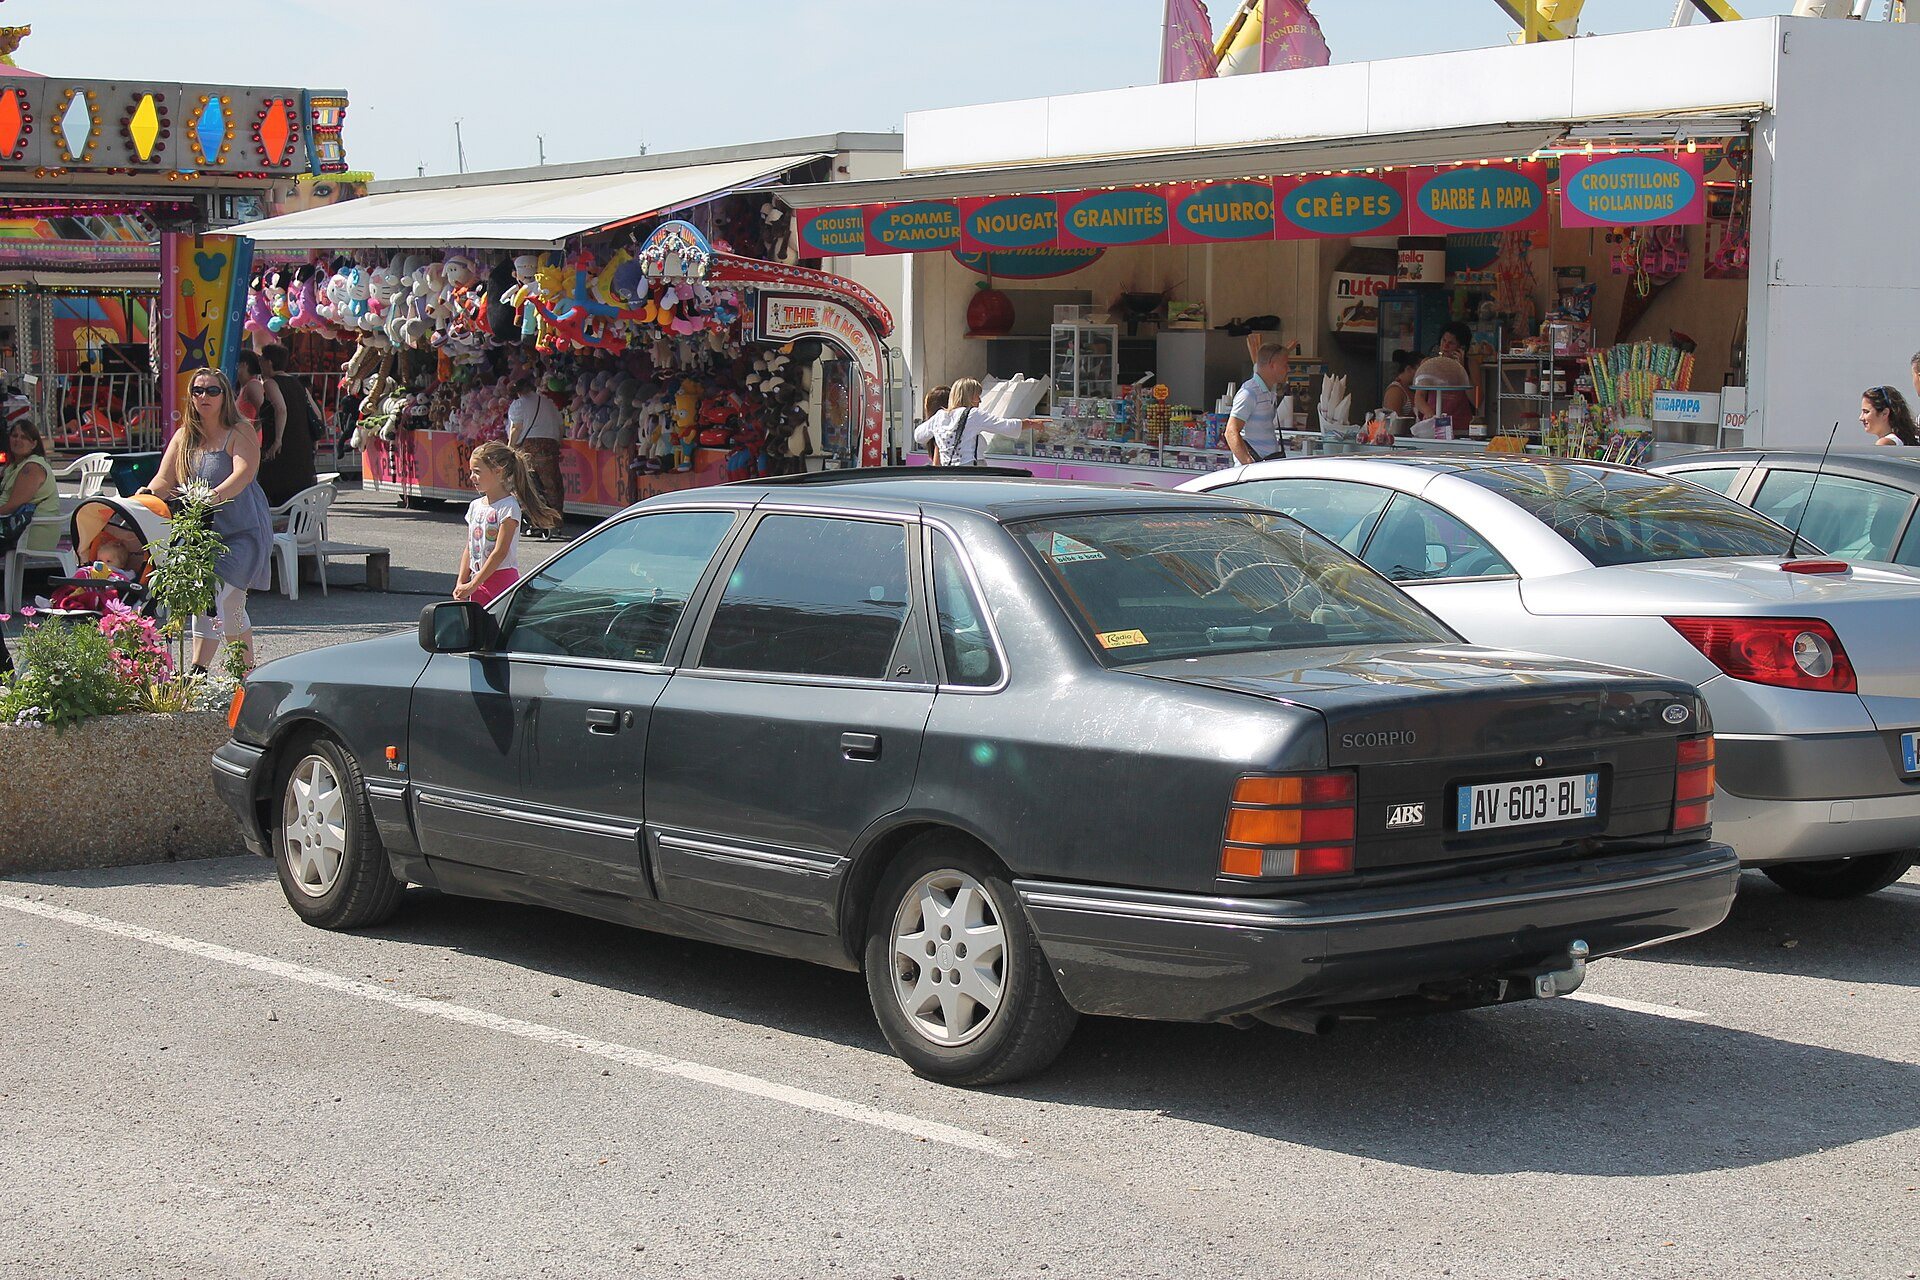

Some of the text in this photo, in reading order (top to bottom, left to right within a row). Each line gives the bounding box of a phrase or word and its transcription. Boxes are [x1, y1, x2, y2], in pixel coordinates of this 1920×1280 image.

[1264, 24, 1307, 46] WONDER
[1581, 171, 1680, 190] CROUSTILLONS
[1295, 190, 1392, 218] CRÊPES
[1430, 186, 1532, 211] BARBE A PAPA
[1588, 193, 1674, 212] HOLLANDAIS
[890, 211, 952, 226] POMME
[1072, 200, 1164, 229] GRANITÉS
[882, 226, 961, 242] D'AMOUR
[782, 305, 865, 347] THE KING
[1105, 633, 1132, 644] Radio
[1668, 706, 1688, 721] Ford
[1341, 730, 1417, 749] SCORPIO
[1387, 803, 1424, 826] ABS
[1461, 812, 1467, 824] F
[1584, 796, 1597, 814] 62
